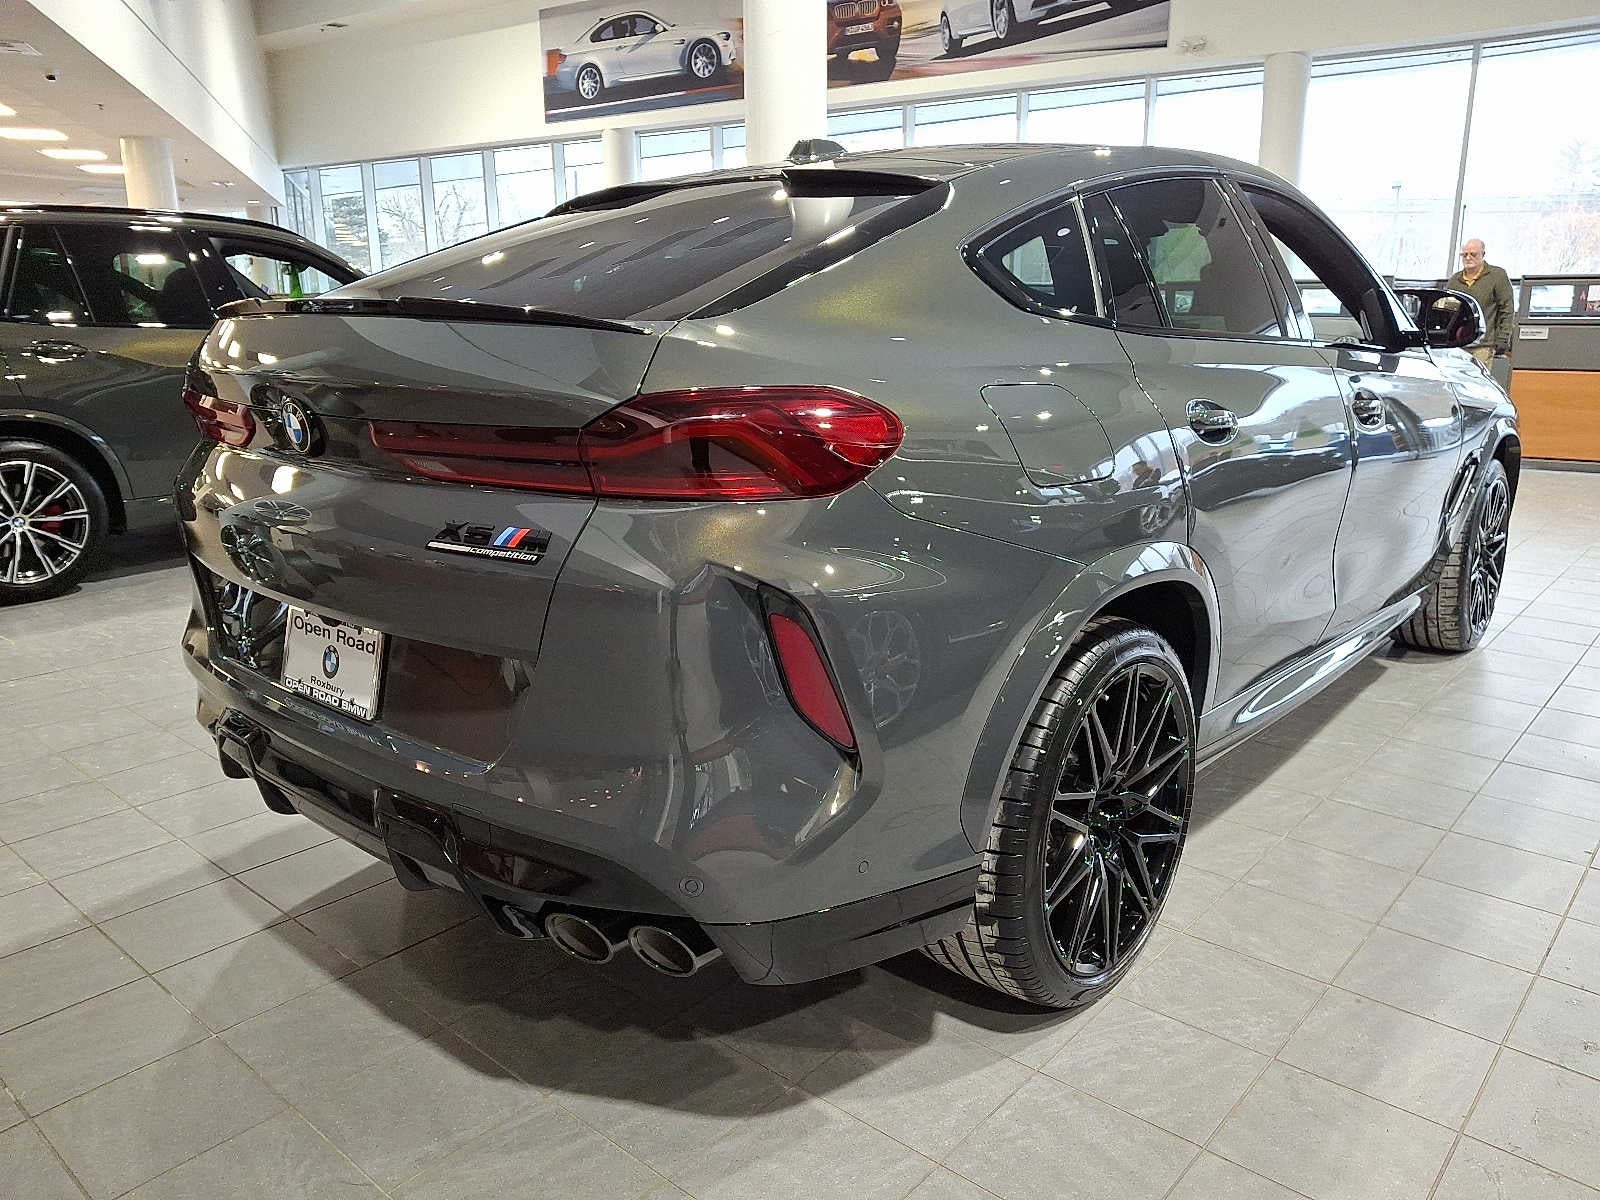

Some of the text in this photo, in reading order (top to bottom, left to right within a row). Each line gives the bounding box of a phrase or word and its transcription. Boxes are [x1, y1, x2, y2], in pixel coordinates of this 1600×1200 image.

[469, 547, 538, 562] competition
[294, 616, 330, 639] Open
[337, 629, 376, 655] Road
[286, 679, 367, 718] OPEN ROAD BMW
[311, 676, 345, 695] Roxbury
